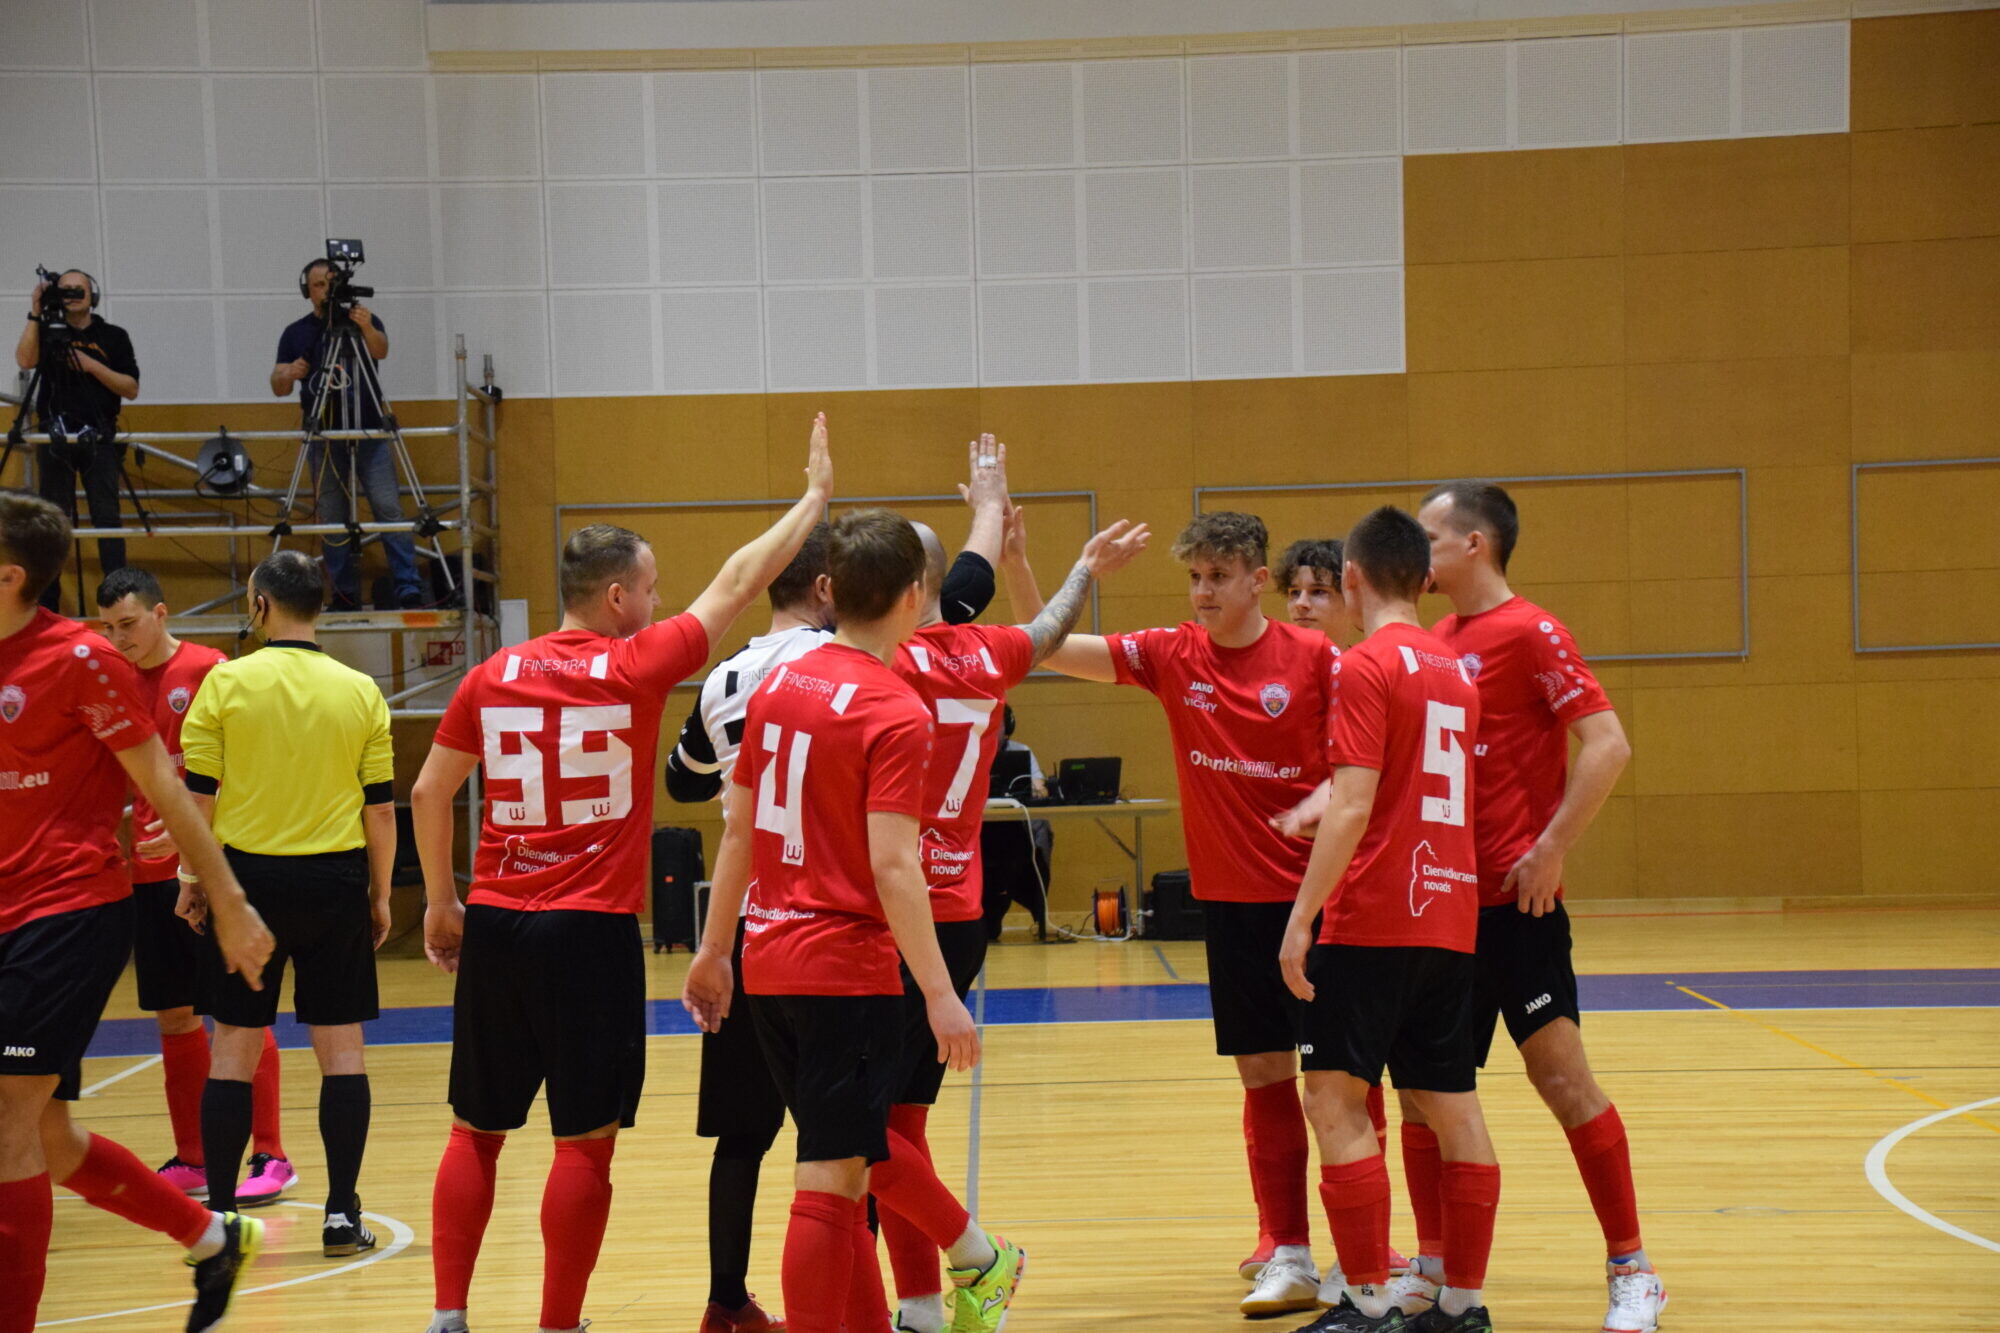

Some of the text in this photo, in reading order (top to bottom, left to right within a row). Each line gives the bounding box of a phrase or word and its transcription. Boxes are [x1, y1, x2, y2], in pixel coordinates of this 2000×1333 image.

[451, 642, 465, 654] 10
[522, 658, 587, 672] FINESTRA
[782, 671, 836, 697] FINESTRA
[1189, 681, 1214, 694] JAKO
[1183, 696, 1218, 714] VICHY
[936, 698, 998, 819] 7
[1421, 700, 1465, 827] 5
[754, 722, 812, 867] 4
[1422, 864, 1478, 884] Dienvidkurzem
[1423, 880, 1452, 894] novads
[1524, 992, 1552, 1015] JAKO
[3, 1045, 36, 1057] JAKO
